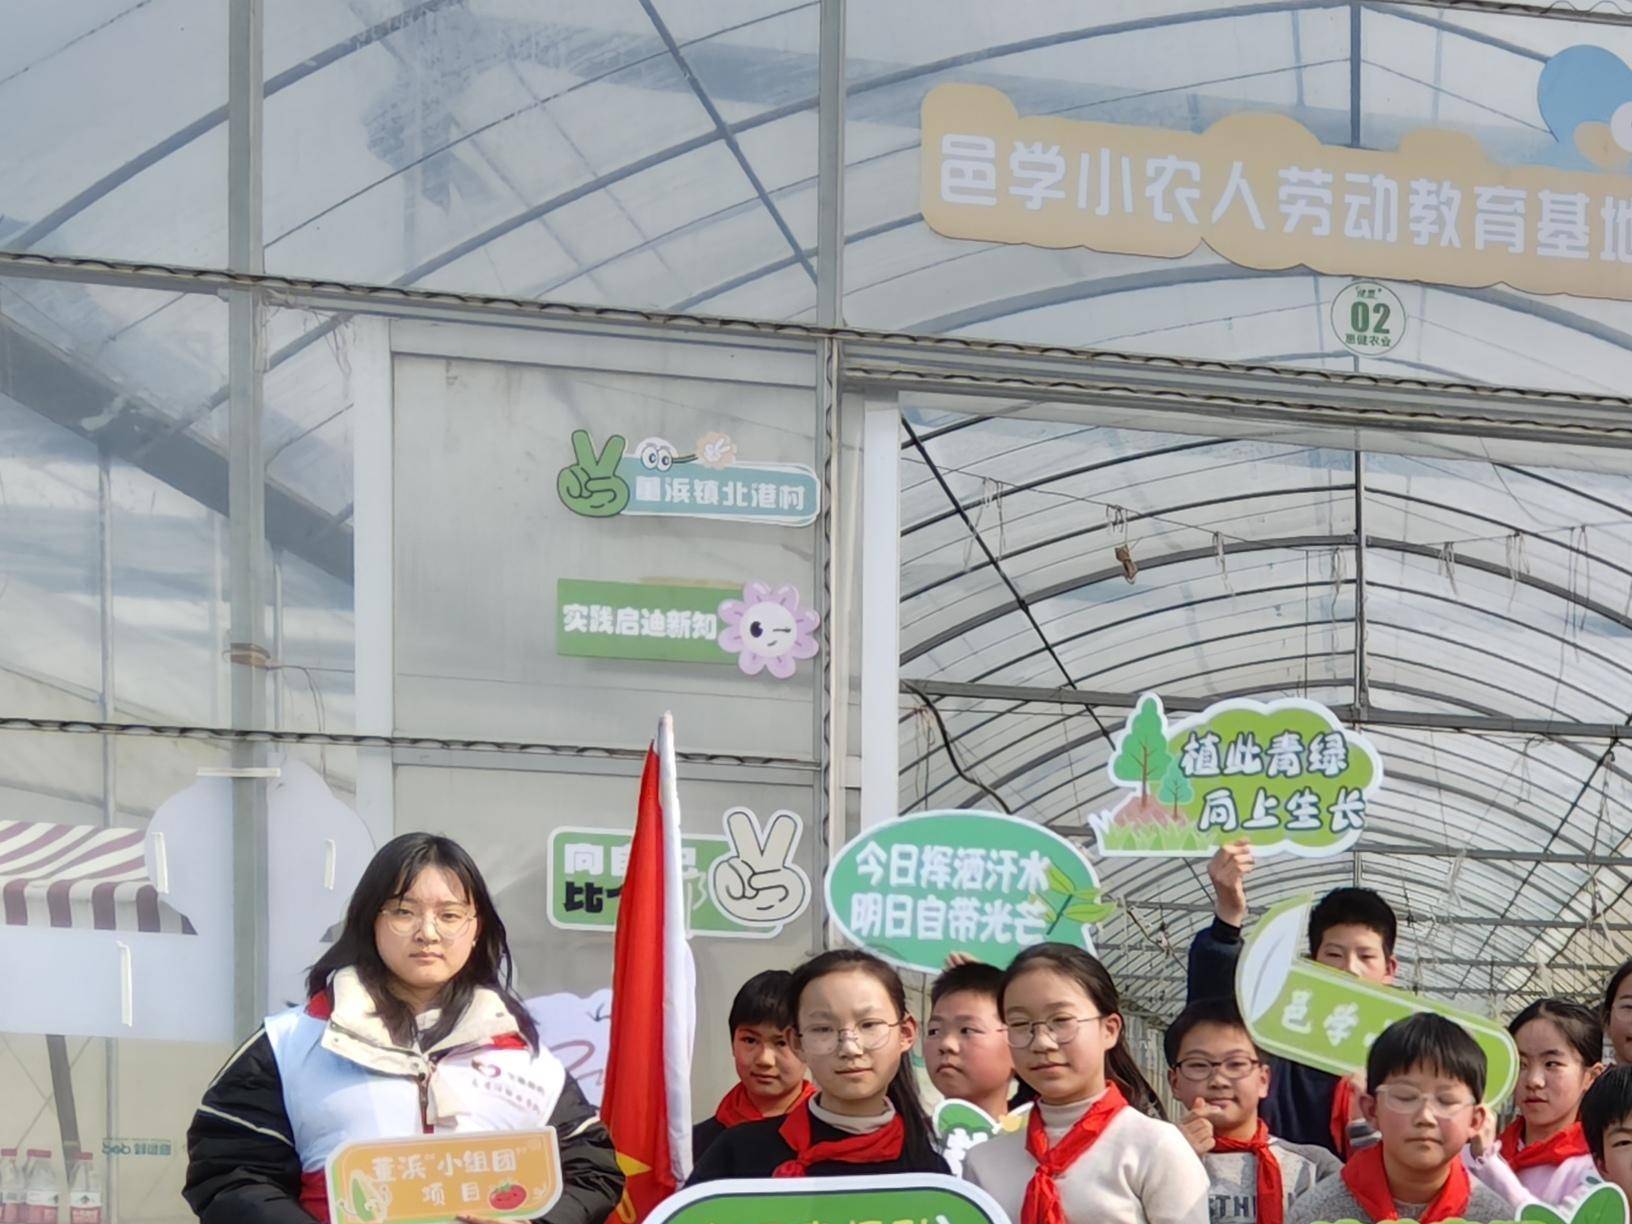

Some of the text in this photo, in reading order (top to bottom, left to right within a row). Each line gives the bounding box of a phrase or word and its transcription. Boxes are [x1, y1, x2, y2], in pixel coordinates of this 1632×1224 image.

[1350, 301, 1391, 334] 02
[635, 475, 806, 511] 董浜镇北港村
[561, 603, 718, 641] 实践启迪新知
[1181, 730, 1350, 778] 植此青绿
[1197, 786, 1367, 833] 向上生长
[855, 840, 1050, 894] 今日挥洒汗水
[850, 891, 1048, 946] 明日自带光芒
[421, 1182, 480, 1207] 项目
